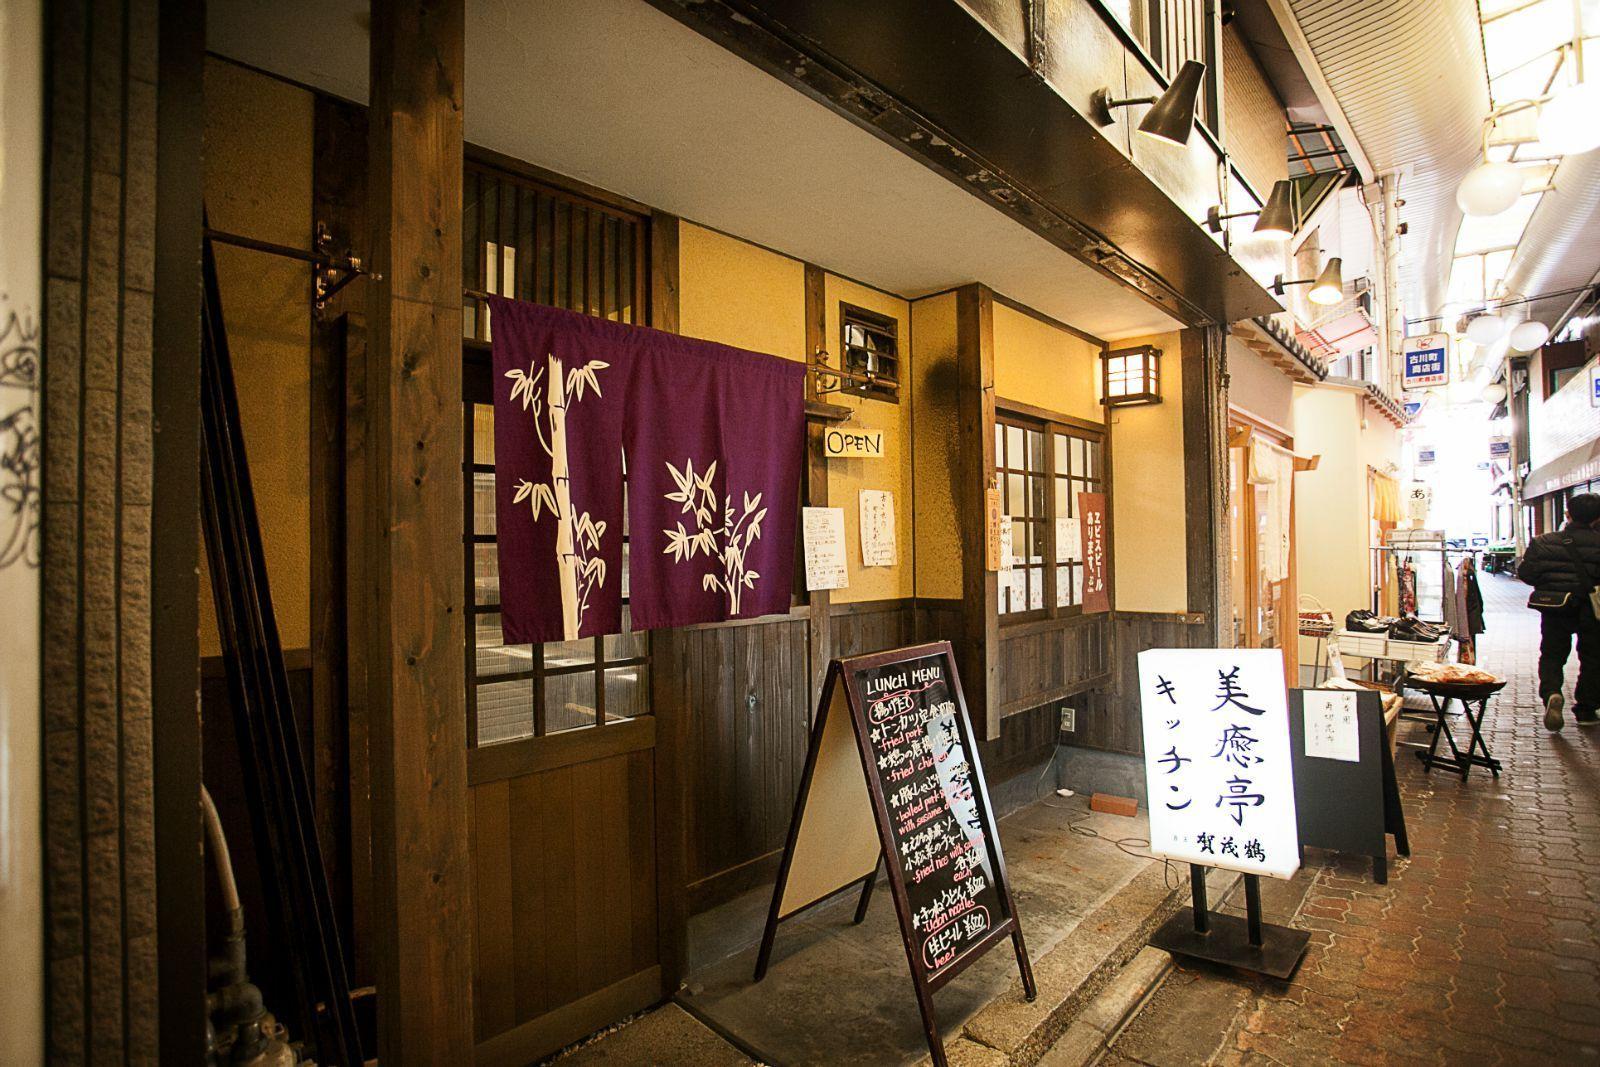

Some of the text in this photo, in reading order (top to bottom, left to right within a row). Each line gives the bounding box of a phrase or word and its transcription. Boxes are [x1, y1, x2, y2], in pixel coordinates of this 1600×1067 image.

[1409, 353, 1438, 365] 古川町
[827, 431, 881, 454] OPEN
[866, 666, 940, 696] LUNCH MENU
[881, 725, 924, 752] fried pork
[1155, 674, 1192, 811] キッチン
[1210, 665, 1266, 827] 美癒亭
[890, 760, 914, 783] fried
[898, 818, 916, 836] with
[1196, 832, 1266, 863] 賀茂鶴
[914, 858, 936, 882] fried
[949, 842, 964, 859] with
[953, 868, 972, 882] each
[928, 922, 963, 958] 生ビール
[934, 946, 956, 969] beer
